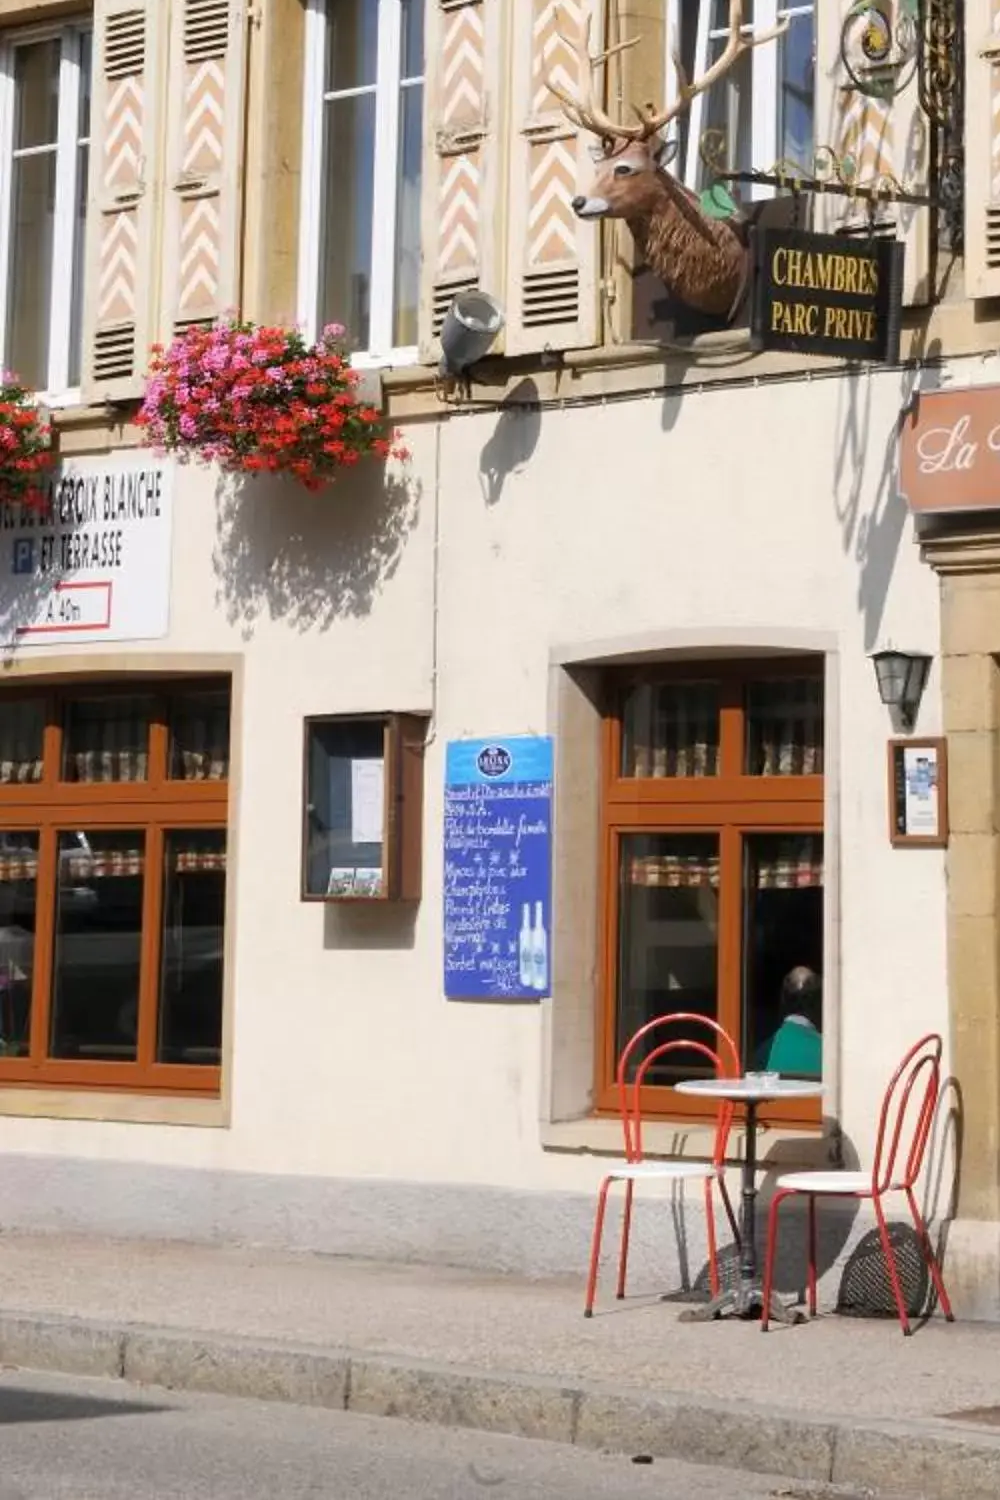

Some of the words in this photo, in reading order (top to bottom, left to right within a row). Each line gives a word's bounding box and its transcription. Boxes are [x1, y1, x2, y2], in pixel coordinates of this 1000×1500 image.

[772, 247, 879, 295] CHAMBRES
[771, 300, 819, 336] PARC
[917, 414, 978, 474] La
[58, 475, 98, 525] CROIX
[104, 471, 162, 520] BLANCHE
[61, 530, 122, 569] TERRASSE
